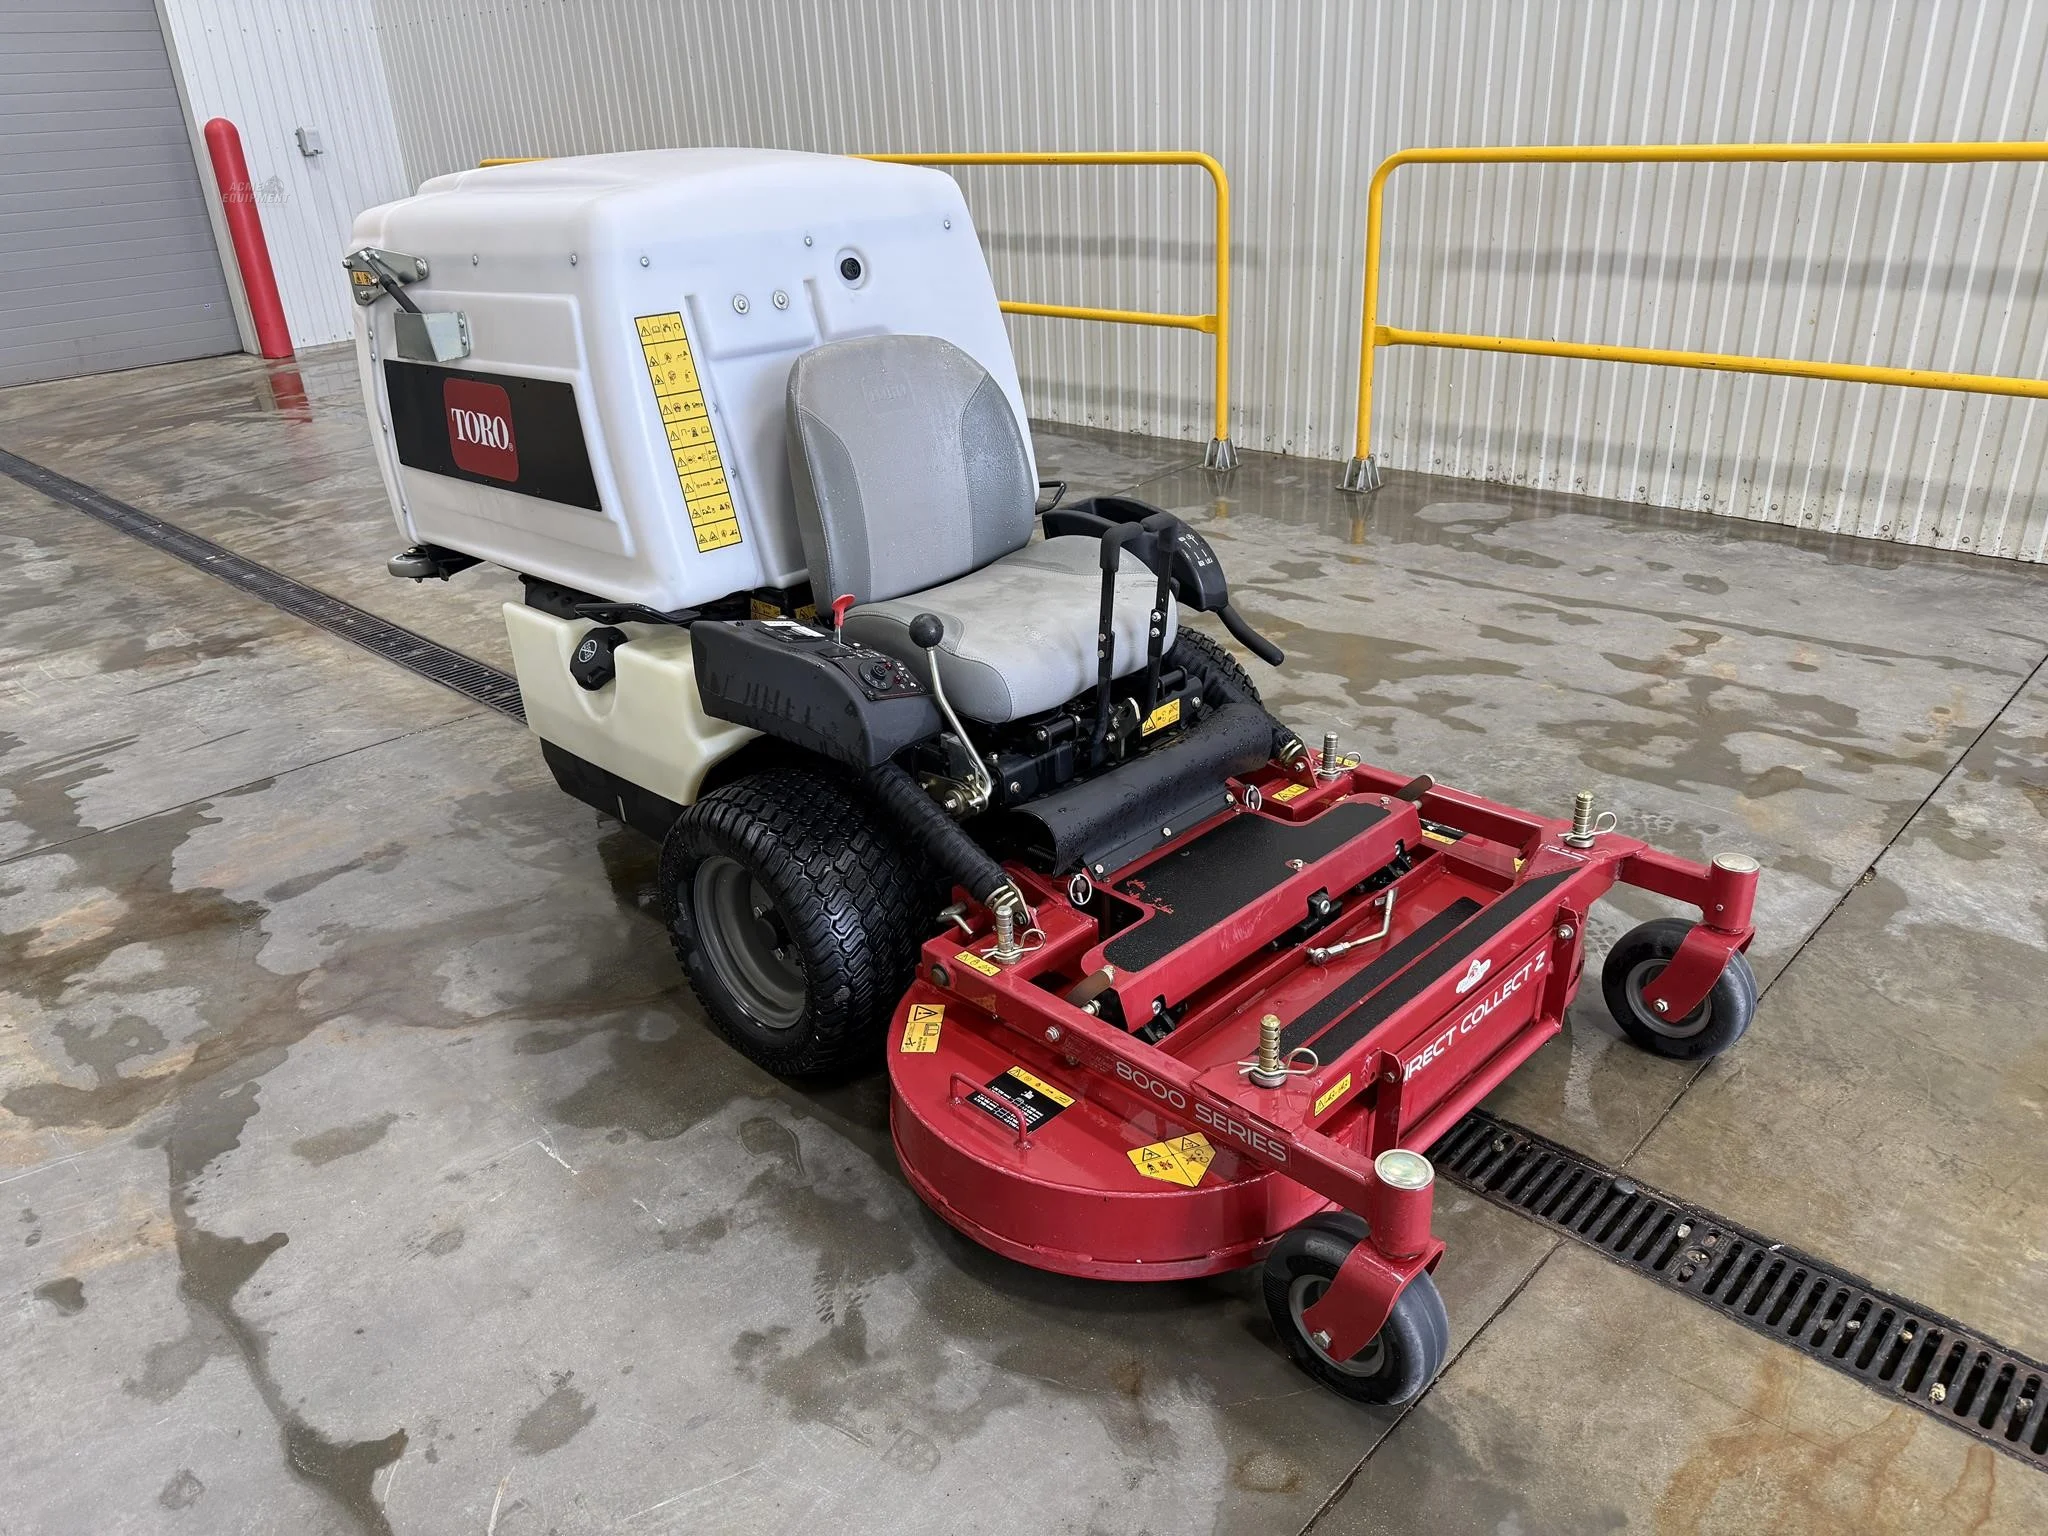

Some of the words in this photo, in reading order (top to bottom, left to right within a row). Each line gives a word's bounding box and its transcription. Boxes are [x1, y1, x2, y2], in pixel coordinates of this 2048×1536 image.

[451, 408, 509, 450] TORO
[1403, 1025, 1457, 1082] IRECT
[1460, 962, 1532, 1033] COLLECT
[1534, 950, 1546, 972] Z
[1116, 1061, 1186, 1109] 8000
[1195, 1103, 1287, 1162] SERIES
